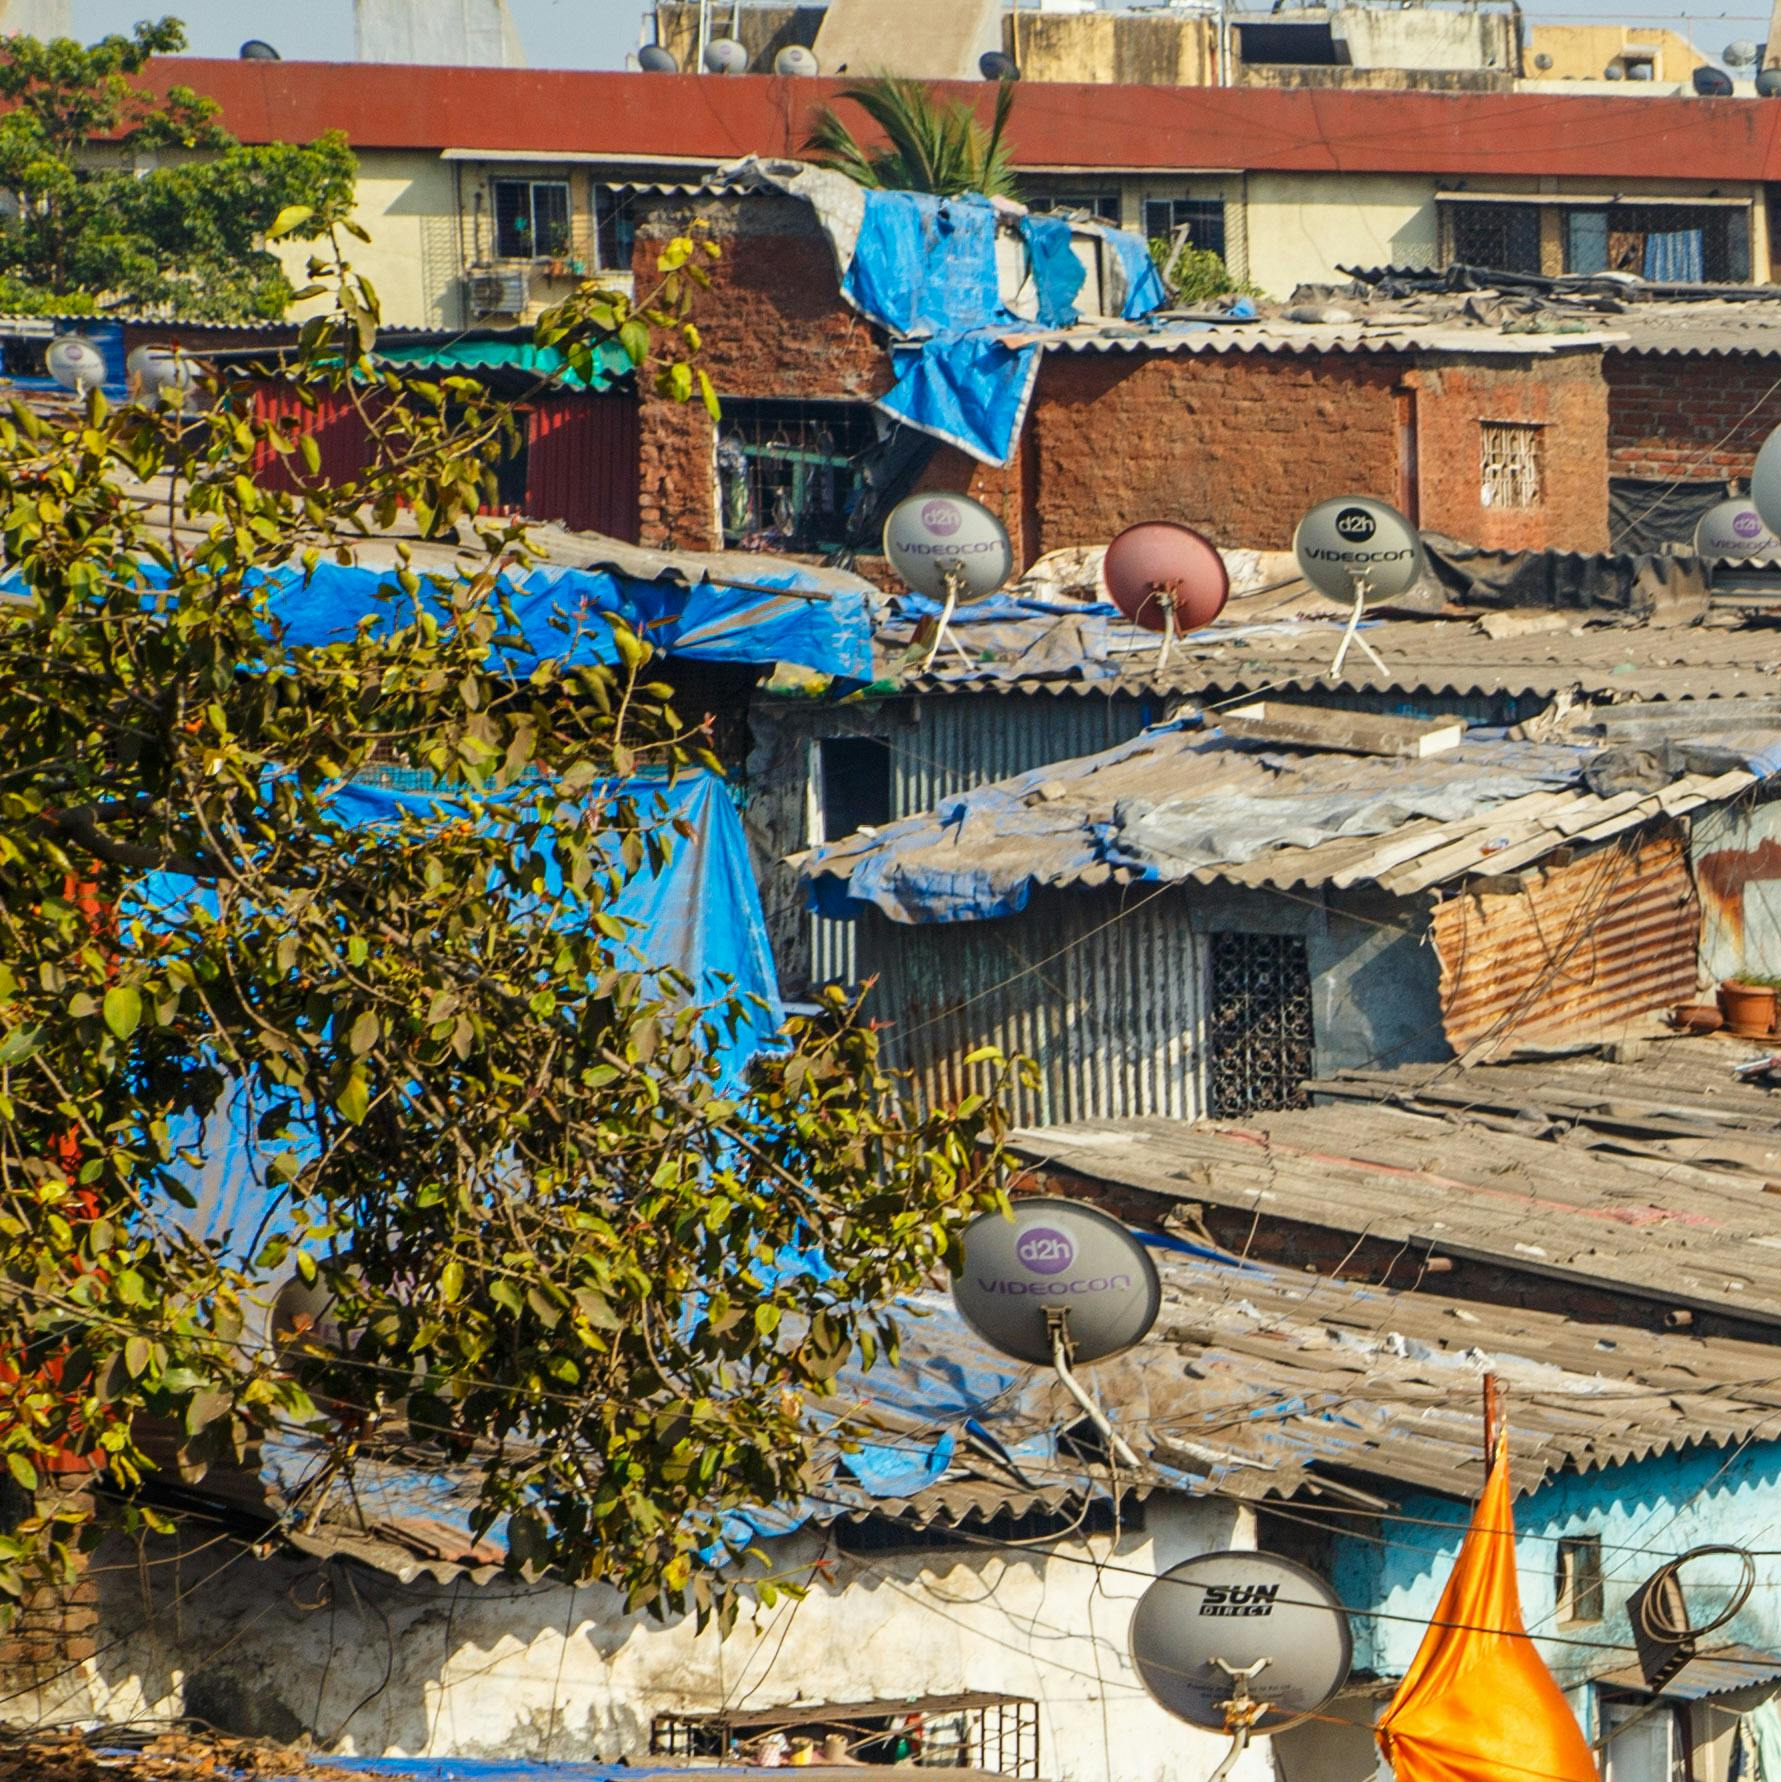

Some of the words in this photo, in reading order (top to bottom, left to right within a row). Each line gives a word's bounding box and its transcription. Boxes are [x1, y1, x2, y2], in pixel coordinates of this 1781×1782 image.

[924, 511, 960, 527] d2h
[1337, 515, 1374, 533] d2h
[1734, 518, 1762, 531] d2h
[897, 539, 1005, 556] VIDEOCON
[1305, 548, 1414, 563] VIDEOCON
[1020, 1238, 1070, 1260] d2h
[977, 1274, 1131, 1296] VIDEOCON
[1203, 1583, 1281, 1605] SUN
[1203, 1605, 1270, 1616] DIRECT
